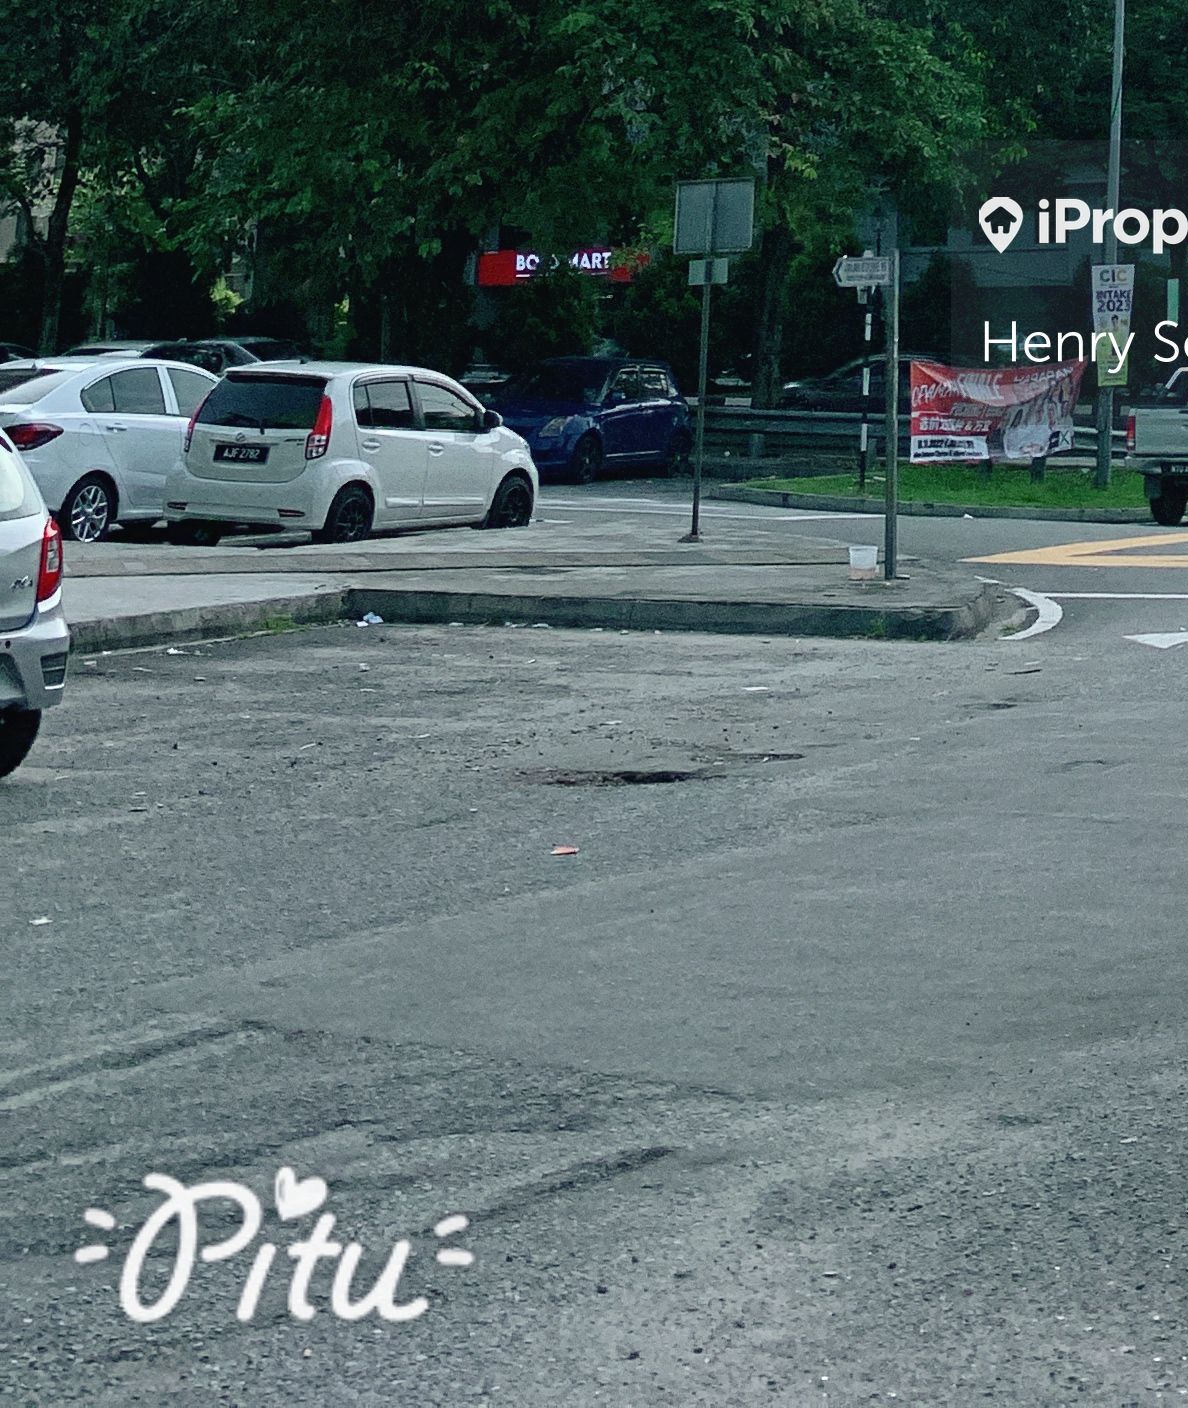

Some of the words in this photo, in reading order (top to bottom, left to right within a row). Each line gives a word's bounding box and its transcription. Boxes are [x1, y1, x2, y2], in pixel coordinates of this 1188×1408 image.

[1100, 269, 1127, 282] CIC
[1096, 289, 1131, 300] INTAKE
[1097, 300, 1131, 313] 2023
